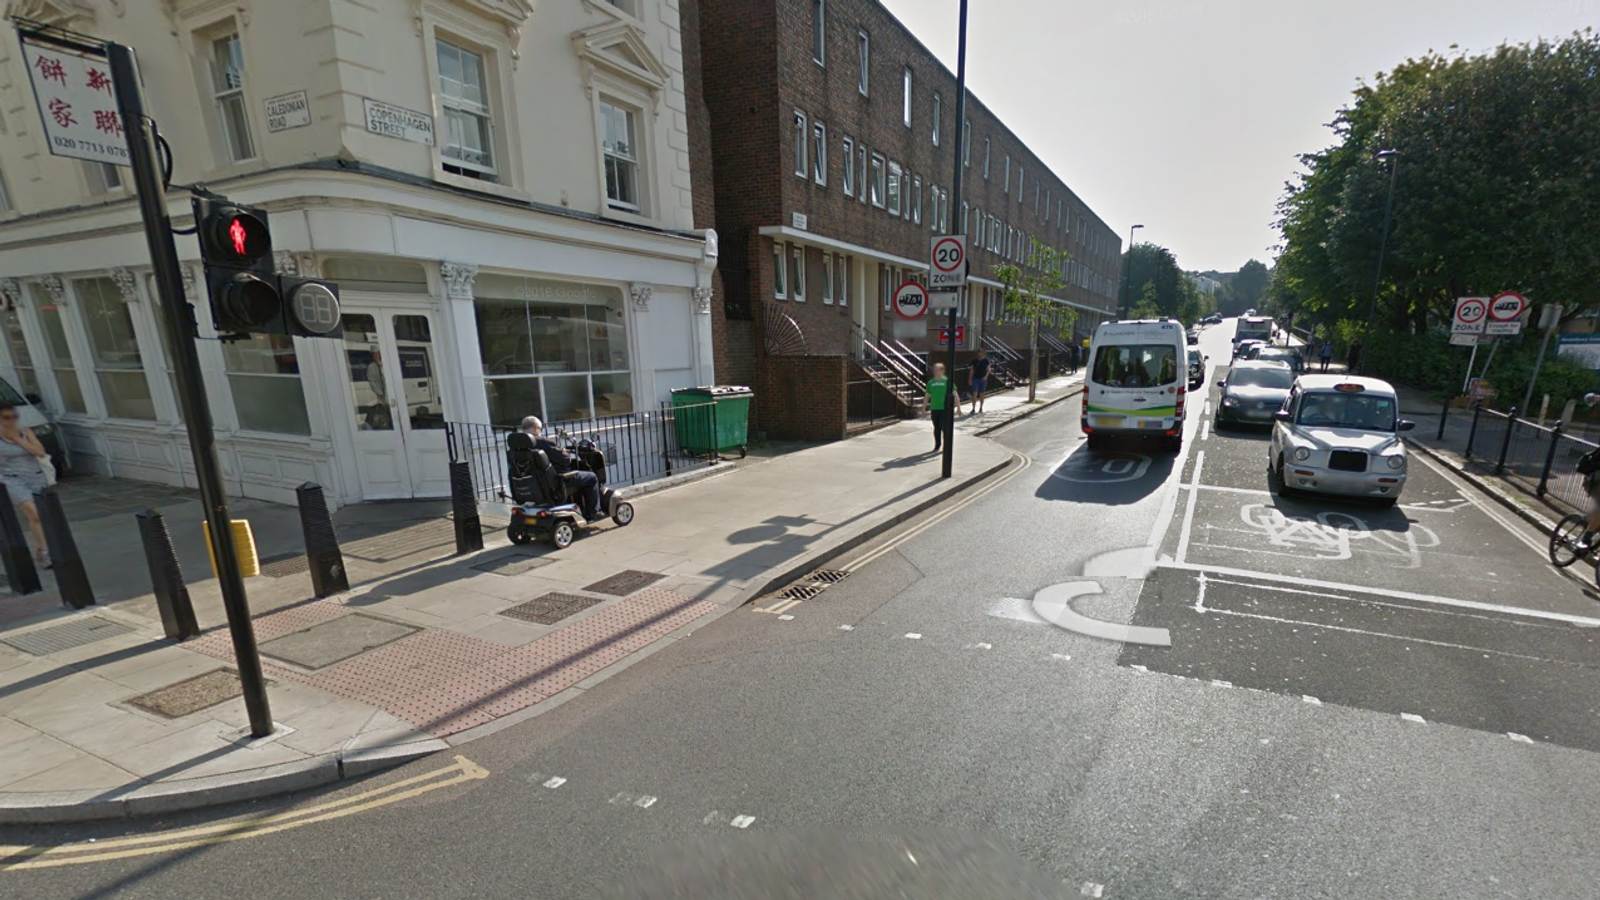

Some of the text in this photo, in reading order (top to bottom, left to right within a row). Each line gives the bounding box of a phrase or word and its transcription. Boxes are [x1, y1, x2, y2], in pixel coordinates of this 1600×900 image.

[267, 100, 306, 117] CALEDONIAN
[269, 115, 287, 129] ROAD
[369, 107, 431, 133] COPENHAGEN
[371, 119, 406, 138] STREET
[54, 136, 130, 158] 020 7713 078
[938, 248, 960, 263] 20
[933, 272, 963, 284] ZONE
[1462, 306, 1482, 317] 20
[1455, 323, 1481, 331] ZONE
